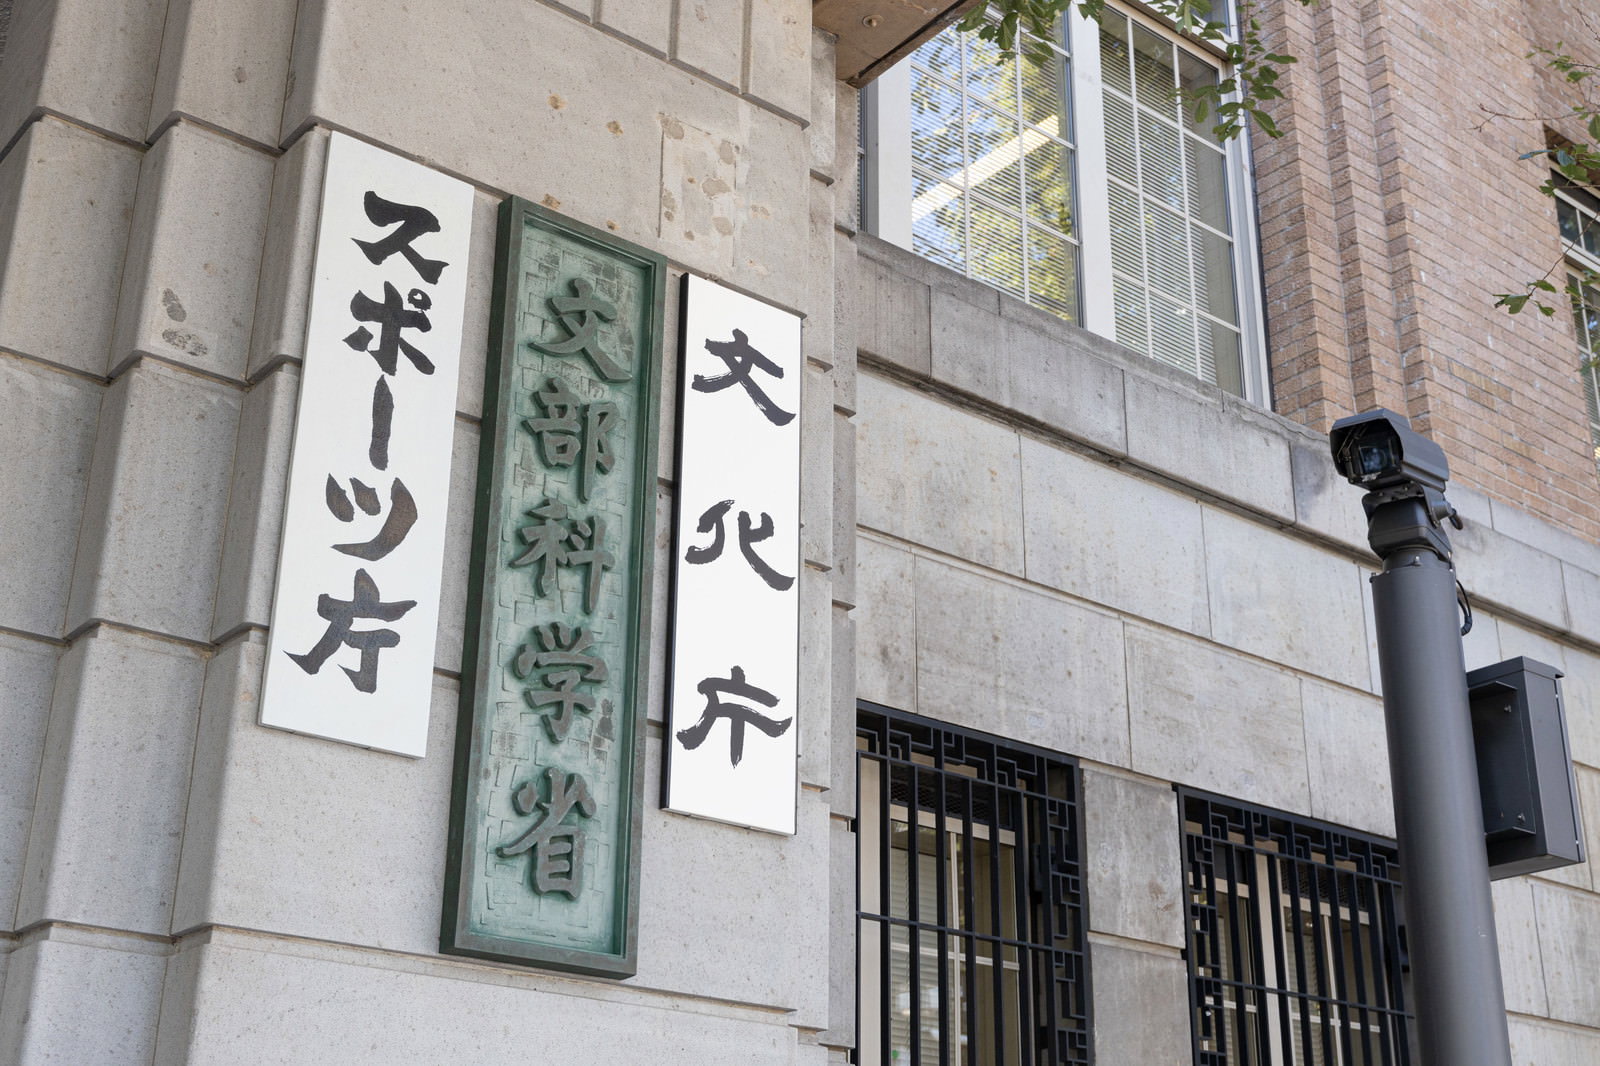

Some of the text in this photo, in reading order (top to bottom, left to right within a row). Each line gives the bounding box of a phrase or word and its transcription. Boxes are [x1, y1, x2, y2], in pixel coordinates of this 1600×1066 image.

[284, 190, 449, 694] スポーツ庁
[496, 277, 632, 900] 文部科学省
[677, 328, 796, 768] 文化庁
